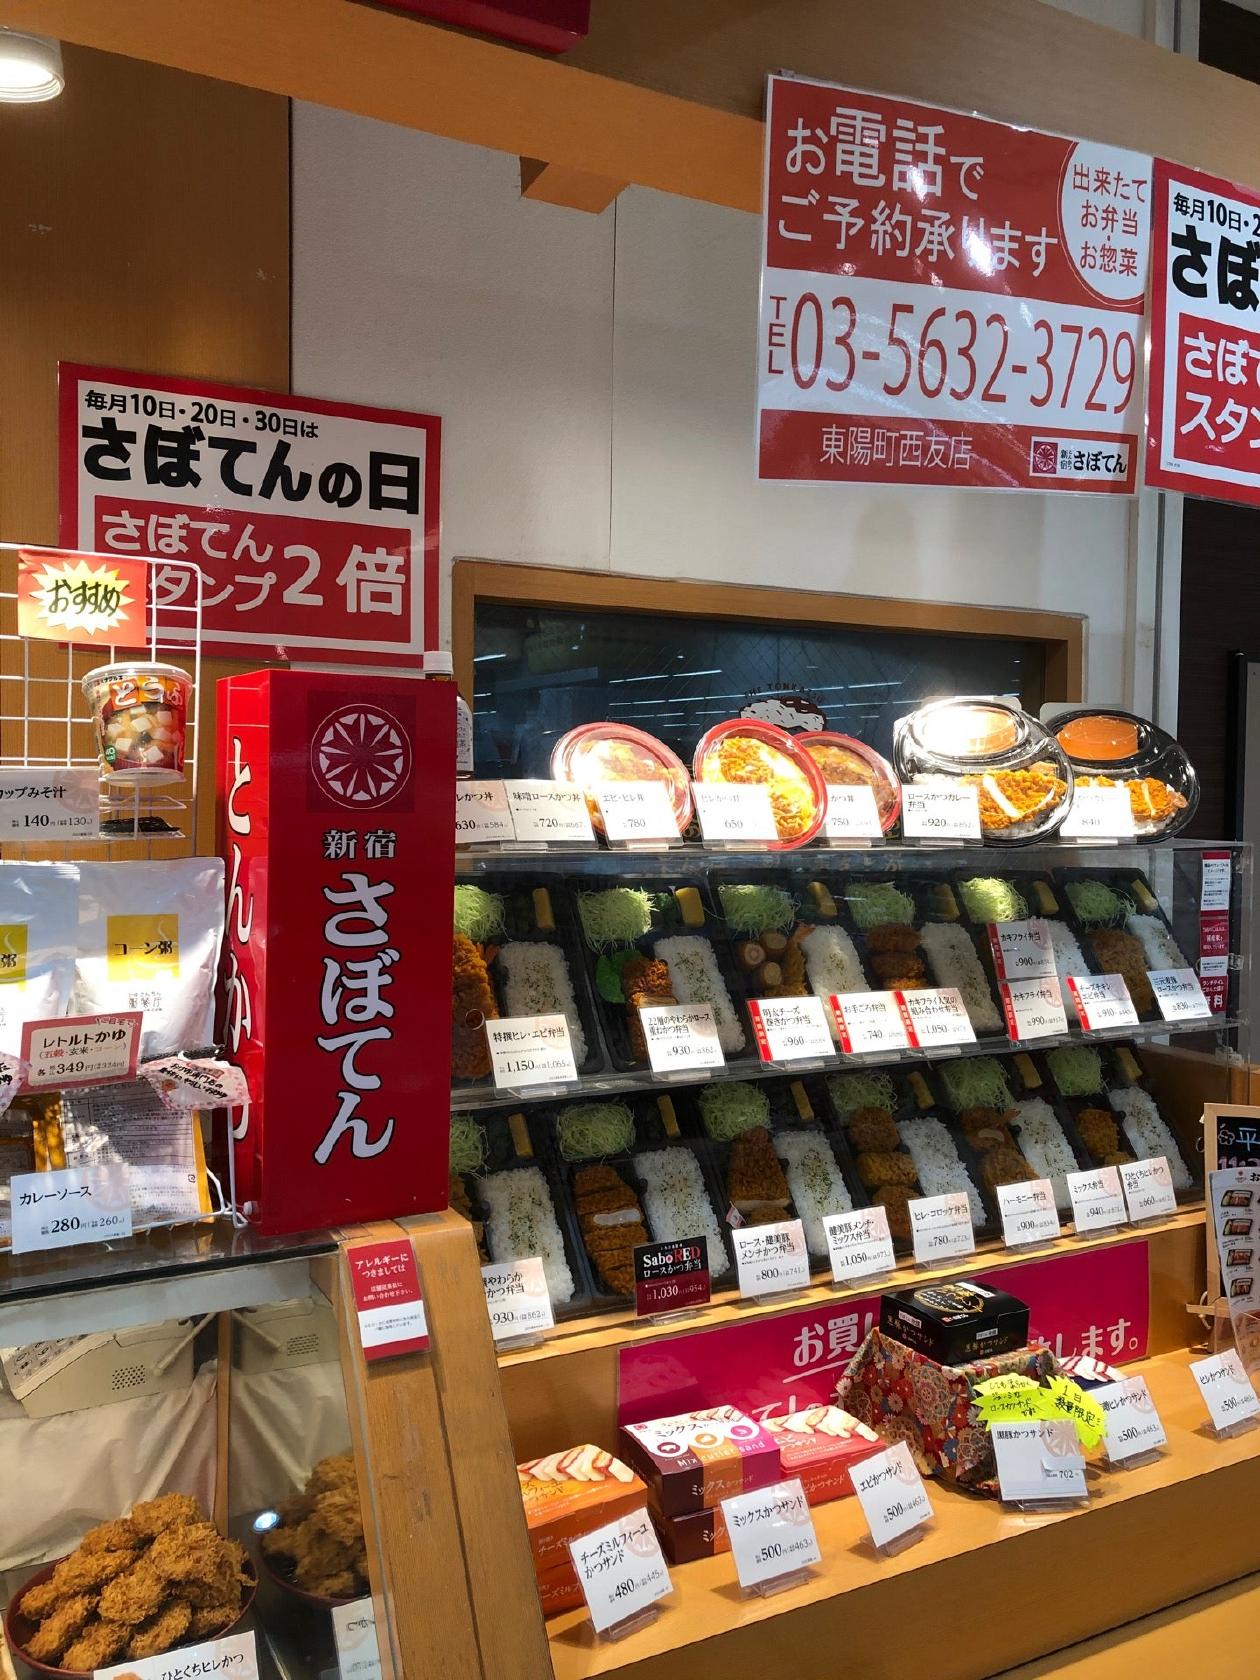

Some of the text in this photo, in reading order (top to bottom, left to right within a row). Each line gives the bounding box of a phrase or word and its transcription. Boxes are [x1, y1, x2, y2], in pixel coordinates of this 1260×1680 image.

[786, 106, 984, 201] お電話で
[1073, 162, 1148, 203] 出来たて
[1081, 199, 1138, 236] お弁当
[778, 188, 1059, 277] ご予約承ります
[1080, 241, 1138, 277] お惣菜
[768, 296, 787, 375] TEL
[790, 292, 1136, 415] 03-5632-3729
[1183, 333, 1260, 386] さぼ
[84, 389, 319, 440] 毎月10日・20日・30日は
[820, 424, 973, 470] 東陽町西友店
[82, 416, 420, 515] さぼてんの日
[1073, 450, 1127, 474] さぼてん
[102, 509, 274, 564] さぼてん
[47, 578, 121, 617] おすすめ
[148, 566, 278, 612] タンプ
[112, 675, 183, 706] とうふ
[907, 801, 926, 809] 弁当
[24, 814, 50, 827] 140
[538, 818, 558, 829] 720
[628, 818, 646, 829] 780
[927, 818, 947, 828] 920
[323, 829, 396, 860] 新宿
[114, 940, 173, 955] コーン粥
[908, 996, 957, 1006] カキフライ人気の
[1013, 990, 1053, 1001] カキフライ弁当
[844, 1002, 886, 1014] お手ごろ弁当
[910, 1004, 959, 1016] 組み合わせ弁当
[312, 873, 401, 1166] さぼてん
[1031, 1016, 1045, 1025] 990
[43, 1028, 127, 1049] レトルトかゆ
[787, 1035, 805, 1046] 960
[672, 1045, 691, 1056] 930
[1125, 1166, 1165, 1181] ひとくちヒレかつ
[1073, 1179, 1105, 1194] ミックス弁当
[1127, 1181, 1140, 1190] 弁当
[19, 1185, 92, 1206] カレーソース
[1004, 1191, 1047, 1206] ハーモニー弁当
[51, 1216, 80, 1233] 280
[832, 1229, 871, 1245] ミックス弁当
[933, 1234, 949, 1246] 780
[643, 1246, 701, 1268] SaboRED
[741, 1241, 795, 1260] メンチかつ弁当
[355, 1253, 409, 1270] アレルギーに
[643, 1259, 702, 1278] ロースかつ弁当
[361, 1264, 407, 1279] つきましては
[761, 1267, 779, 1280] 800
[486, 1283, 525, 1299] かつ弁当
[653, 1284, 679, 1300] 1,030
[492, 1311, 514, 1325] 930
[1199, 1364, 1235, 1385] ヒレかつサンド
[1223, 1397, 1238, 1410] 500
[1121, 1426, 1138, 1442] 500
[676, 1457, 698, 1467] Mix
[739, 1440, 766, 1453] sand
[859, 1460, 903, 1493] エビかつサンド
[732, 1495, 804, 1527] ミックスかつサンド
[886, 1501, 904, 1521] 500
[580, 1522, 649, 1564] チーズミルフィーユ
[760, 1543, 782, 1562] 500
[583, 1550, 625, 1580] かつサンド
[614, 1578, 636, 1600] 480
